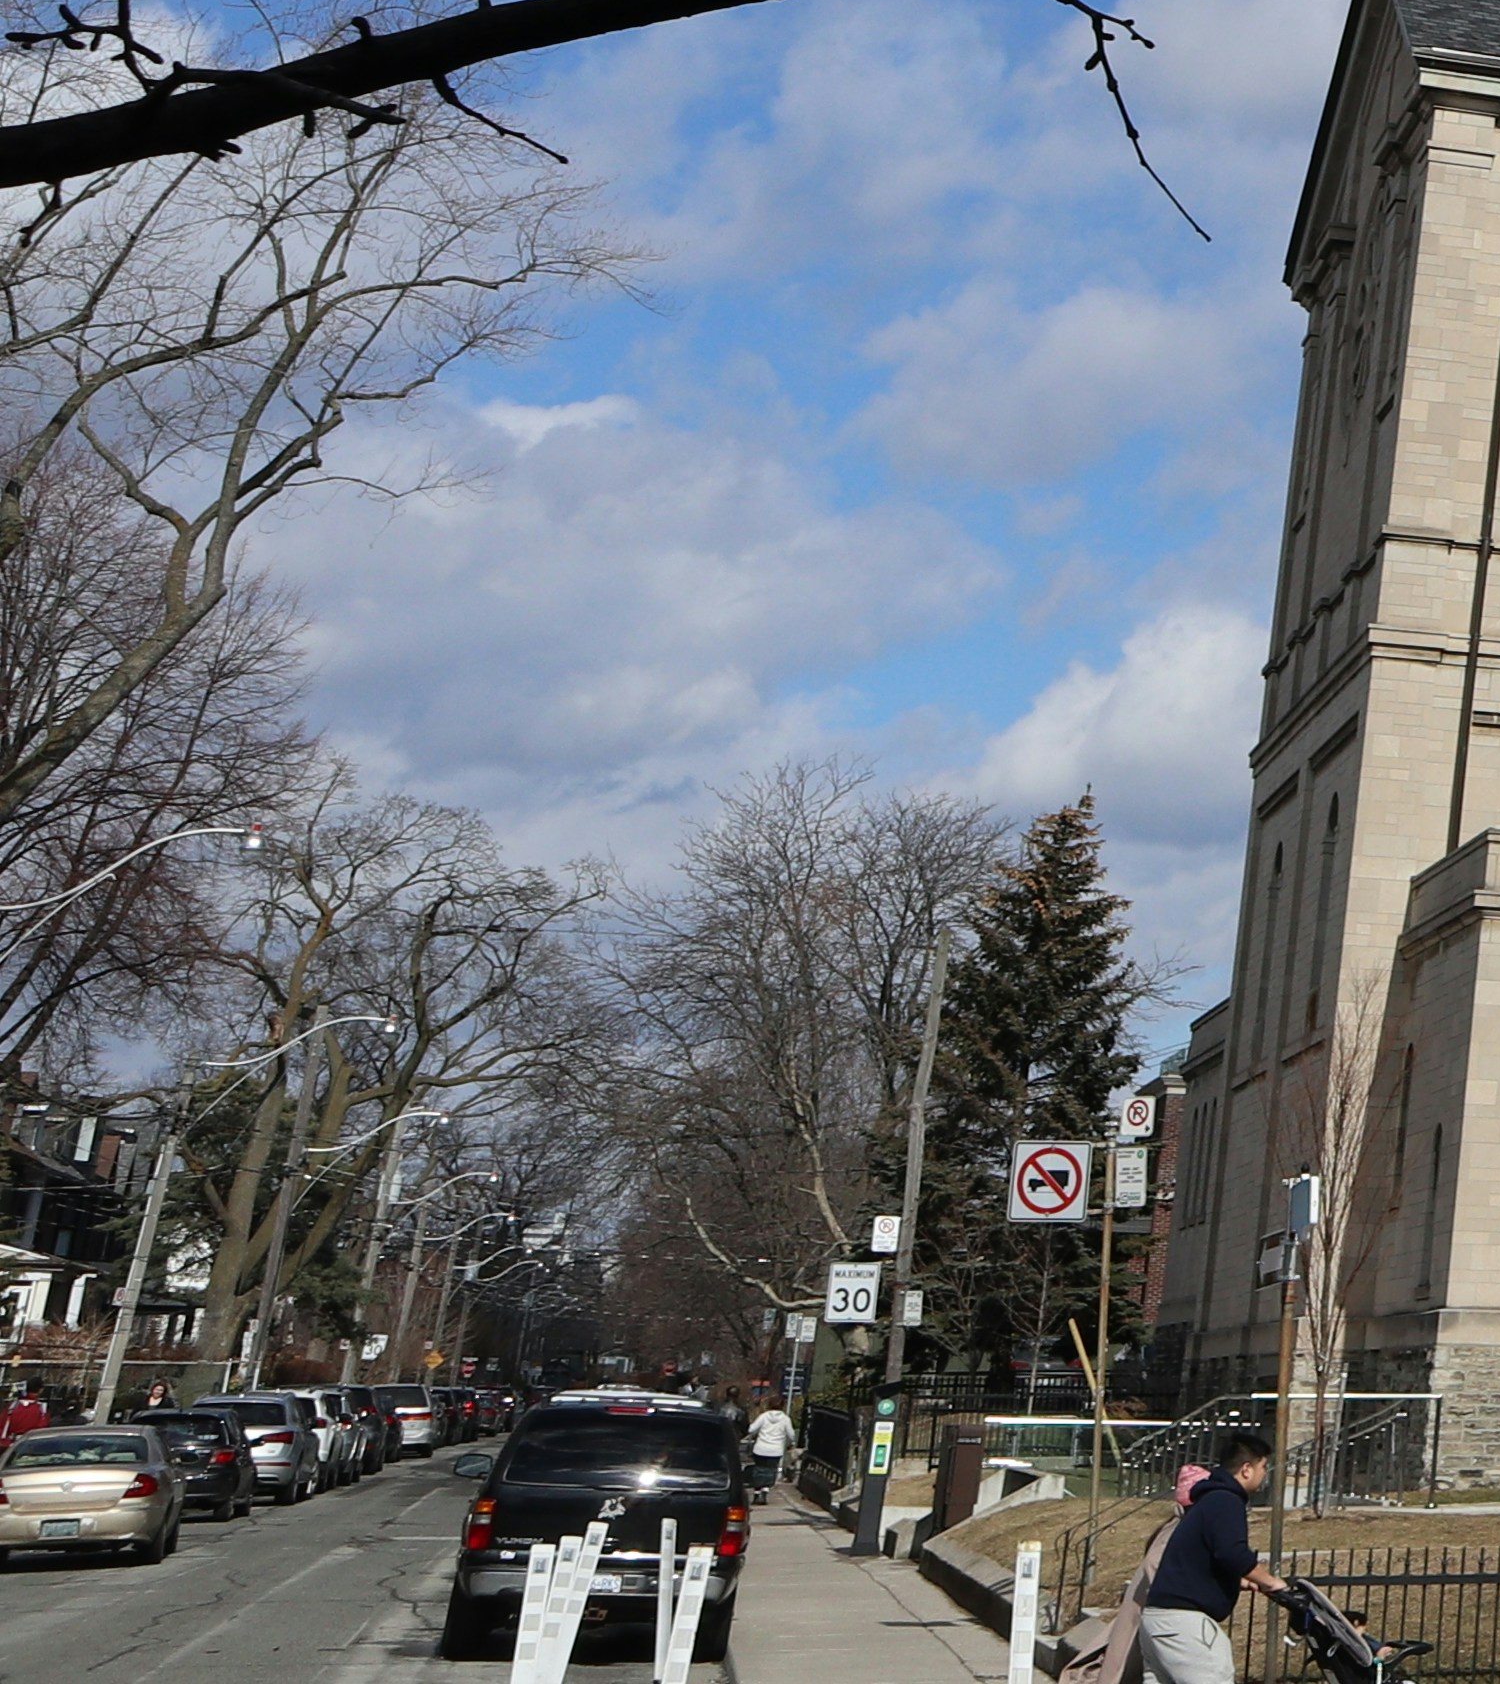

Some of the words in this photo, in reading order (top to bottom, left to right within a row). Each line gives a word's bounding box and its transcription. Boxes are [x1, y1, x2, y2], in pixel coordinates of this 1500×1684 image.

[834, 1270, 875, 1278] MAXIMUM
[832, 1288, 871, 1312] 30
[365, 1345, 383, 1355] 30
